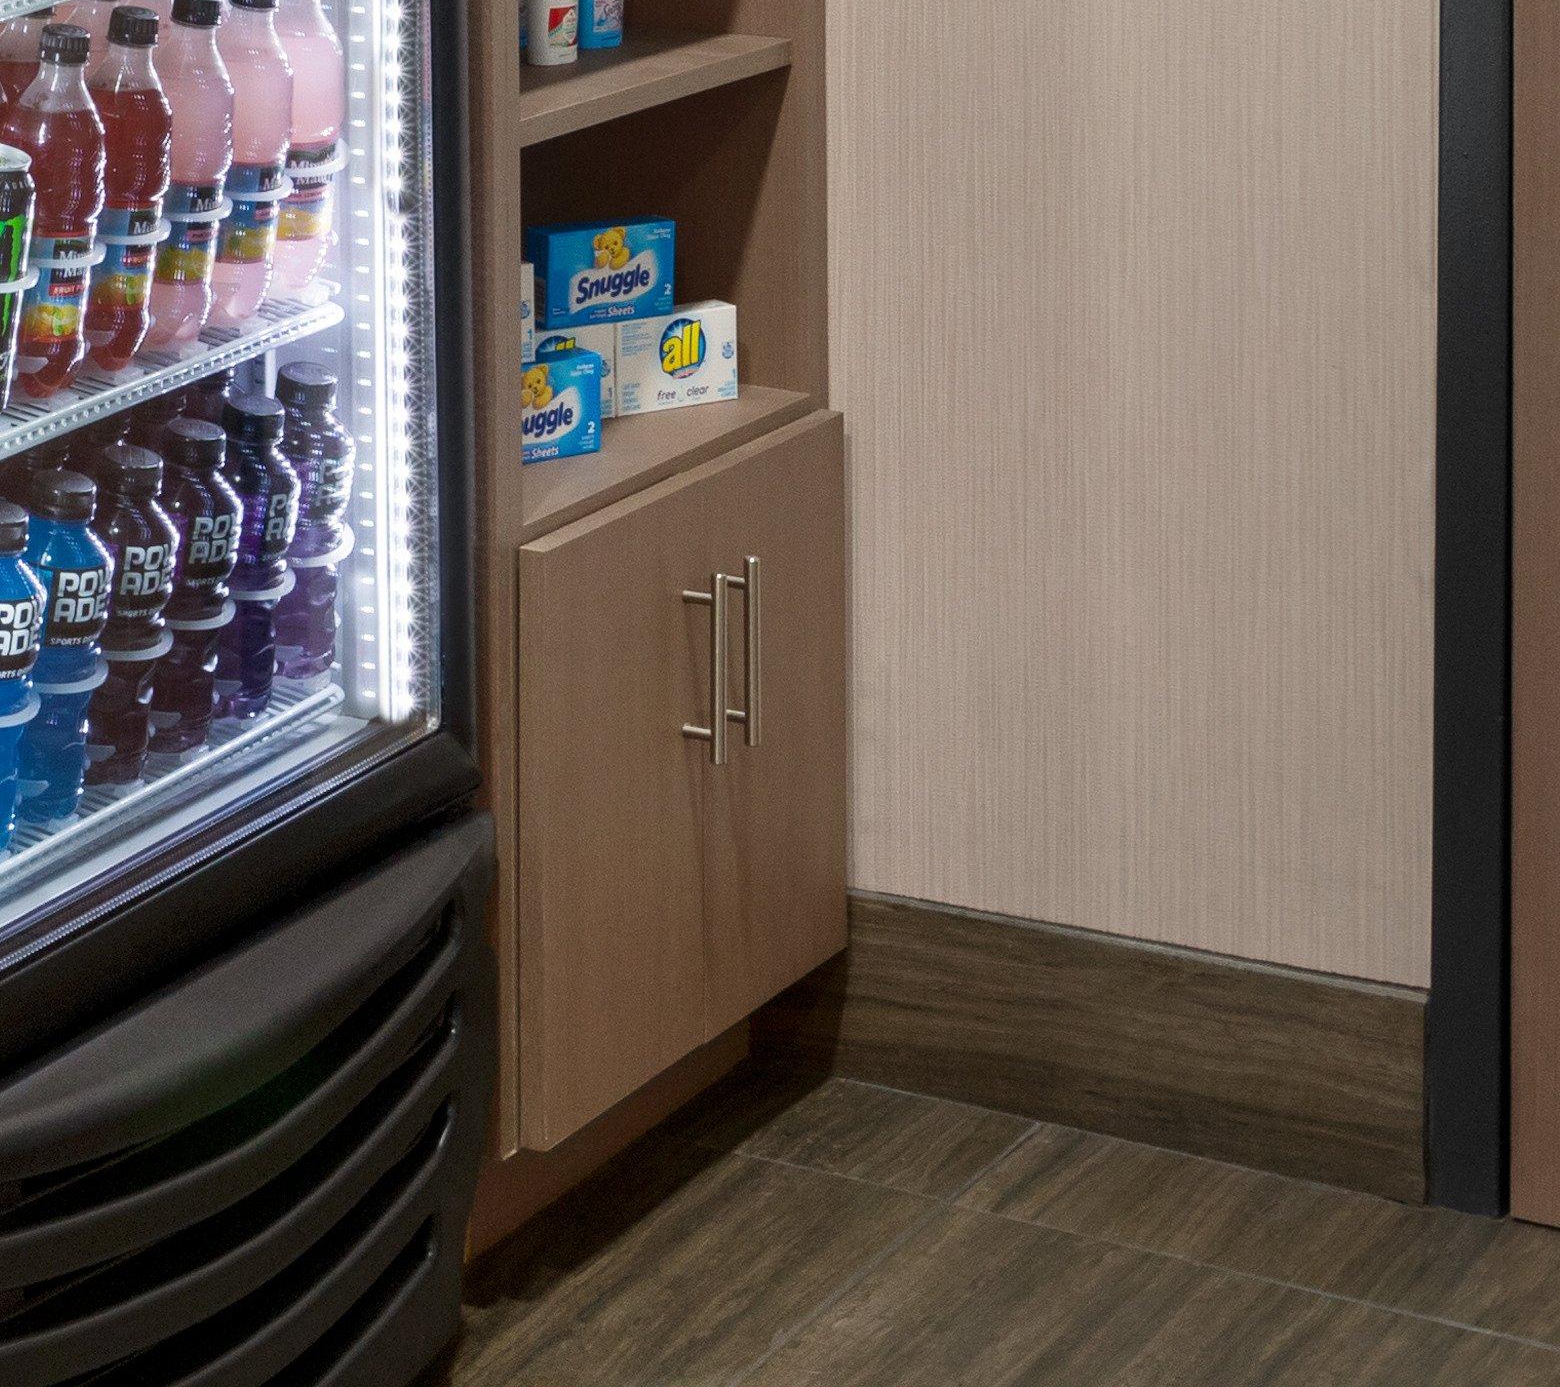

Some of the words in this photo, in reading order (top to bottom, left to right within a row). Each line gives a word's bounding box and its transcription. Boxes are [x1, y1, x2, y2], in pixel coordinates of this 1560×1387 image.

[576, 264, 651, 305] Snuggle
[608, 304, 635, 318] Sheets
[661, 319, 702, 374] all
[657, 389, 677, 401] free
[686, 385, 710, 398] clear
